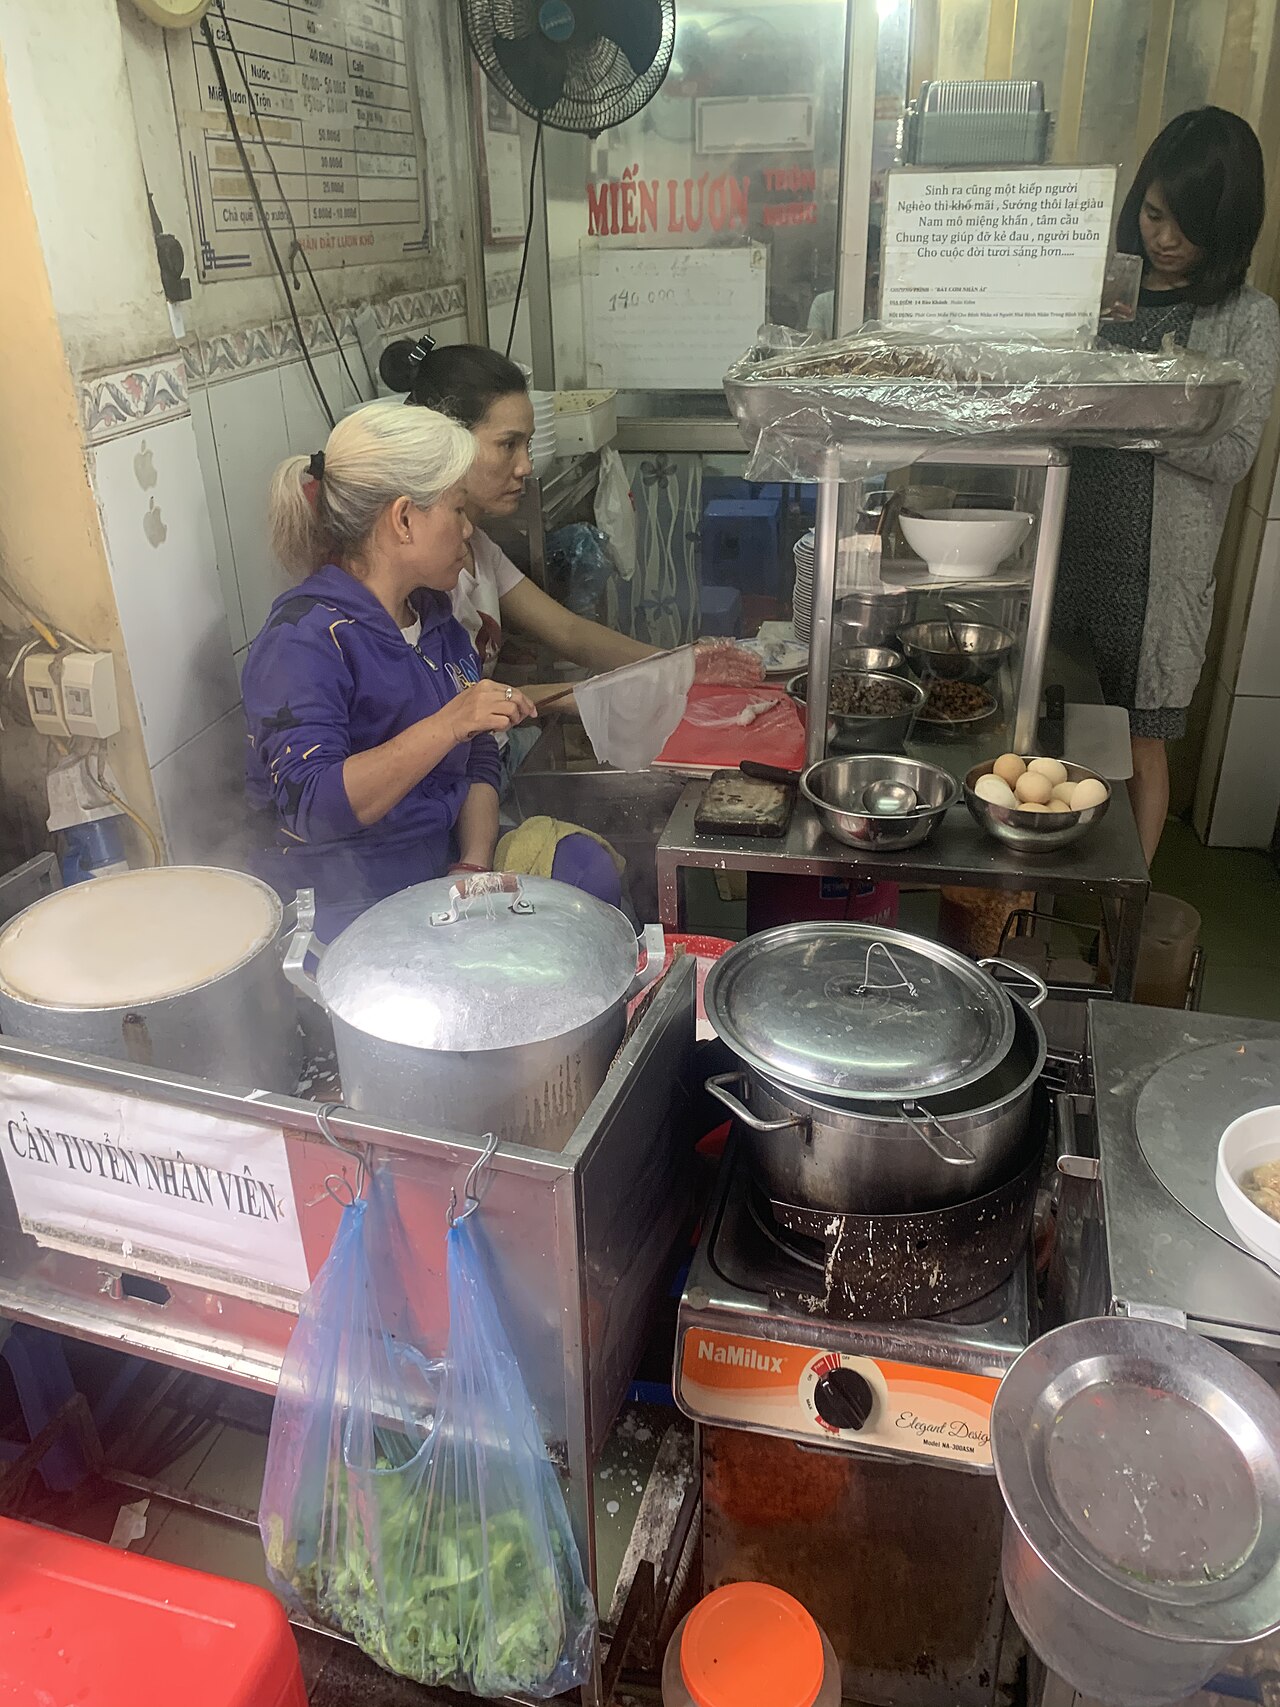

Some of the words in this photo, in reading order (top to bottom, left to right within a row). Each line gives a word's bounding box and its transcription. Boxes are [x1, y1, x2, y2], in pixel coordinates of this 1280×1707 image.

[251, 64, 271, 81] Nước
[254, 92, 272, 111] Trộn
[925, 184, 949, 196] Sinh
[952, 187, 963, 195] ra
[965, 184, 992, 197] cũng
[994, 183, 1016, 197] một
[1018, 182, 1043, 196] kiếp
[1045, 182, 1078, 196] người
[586, 163, 660, 236] MIẾN
[667, 170, 751, 233] LƯƠN
[897, 200, 931, 213] Nghèo
[934, 199, 948, 211] thì
[974, 199, 994, 210] mãi
[1002, 198, 1038, 213] Sướng
[1040, 198, 1061, 210] thôi
[1064, 198, 1078, 212] lại
[1080, 197, 1104, 212] giàu
[919, 216, 943, 227] Nam
[946, 215, 963, 227] mô
[965, 215, 999, 228] miệng
[1001, 214, 1028, 226] khấn
[1036, 214, 1057, 225] tâm
[1060, 213, 1079, 225] cầu
[896, 232, 929, 245] Chung
[931, 233, 948, 245] tay
[950, 231, 974, 245] giúp
[976, 231, 992, 242] đỡ
[993, 231, 1007, 242] kẻ
[1009, 230, 1029, 242] đau
[1037, 230, 1070, 244] người
[1072, 229, 1100, 241] buồn
[917, 247, 937, 258] Cho
[940, 246, 965, 259] cuộc
[966, 246, 985, 257] đời
[987, 246, 1010, 257] tươi
[1012, 246, 1038, 259] sáng
[7, 1110, 59, 1167] CẦN
[55, 1131, 141, 1188] TUYỂN
[140, 1149, 215, 1207] NHÂN
[216, 1165, 279, 1223] VIÊN
[698, 1339, 783, 1374] NaMilux
[895, 1411, 948, 1437] Elegant
[948, 1420, 991, 1447] Desig
[922, 1438, 941, 1448] Model
[941, 1442, 975, 1454] NA-300ASM
